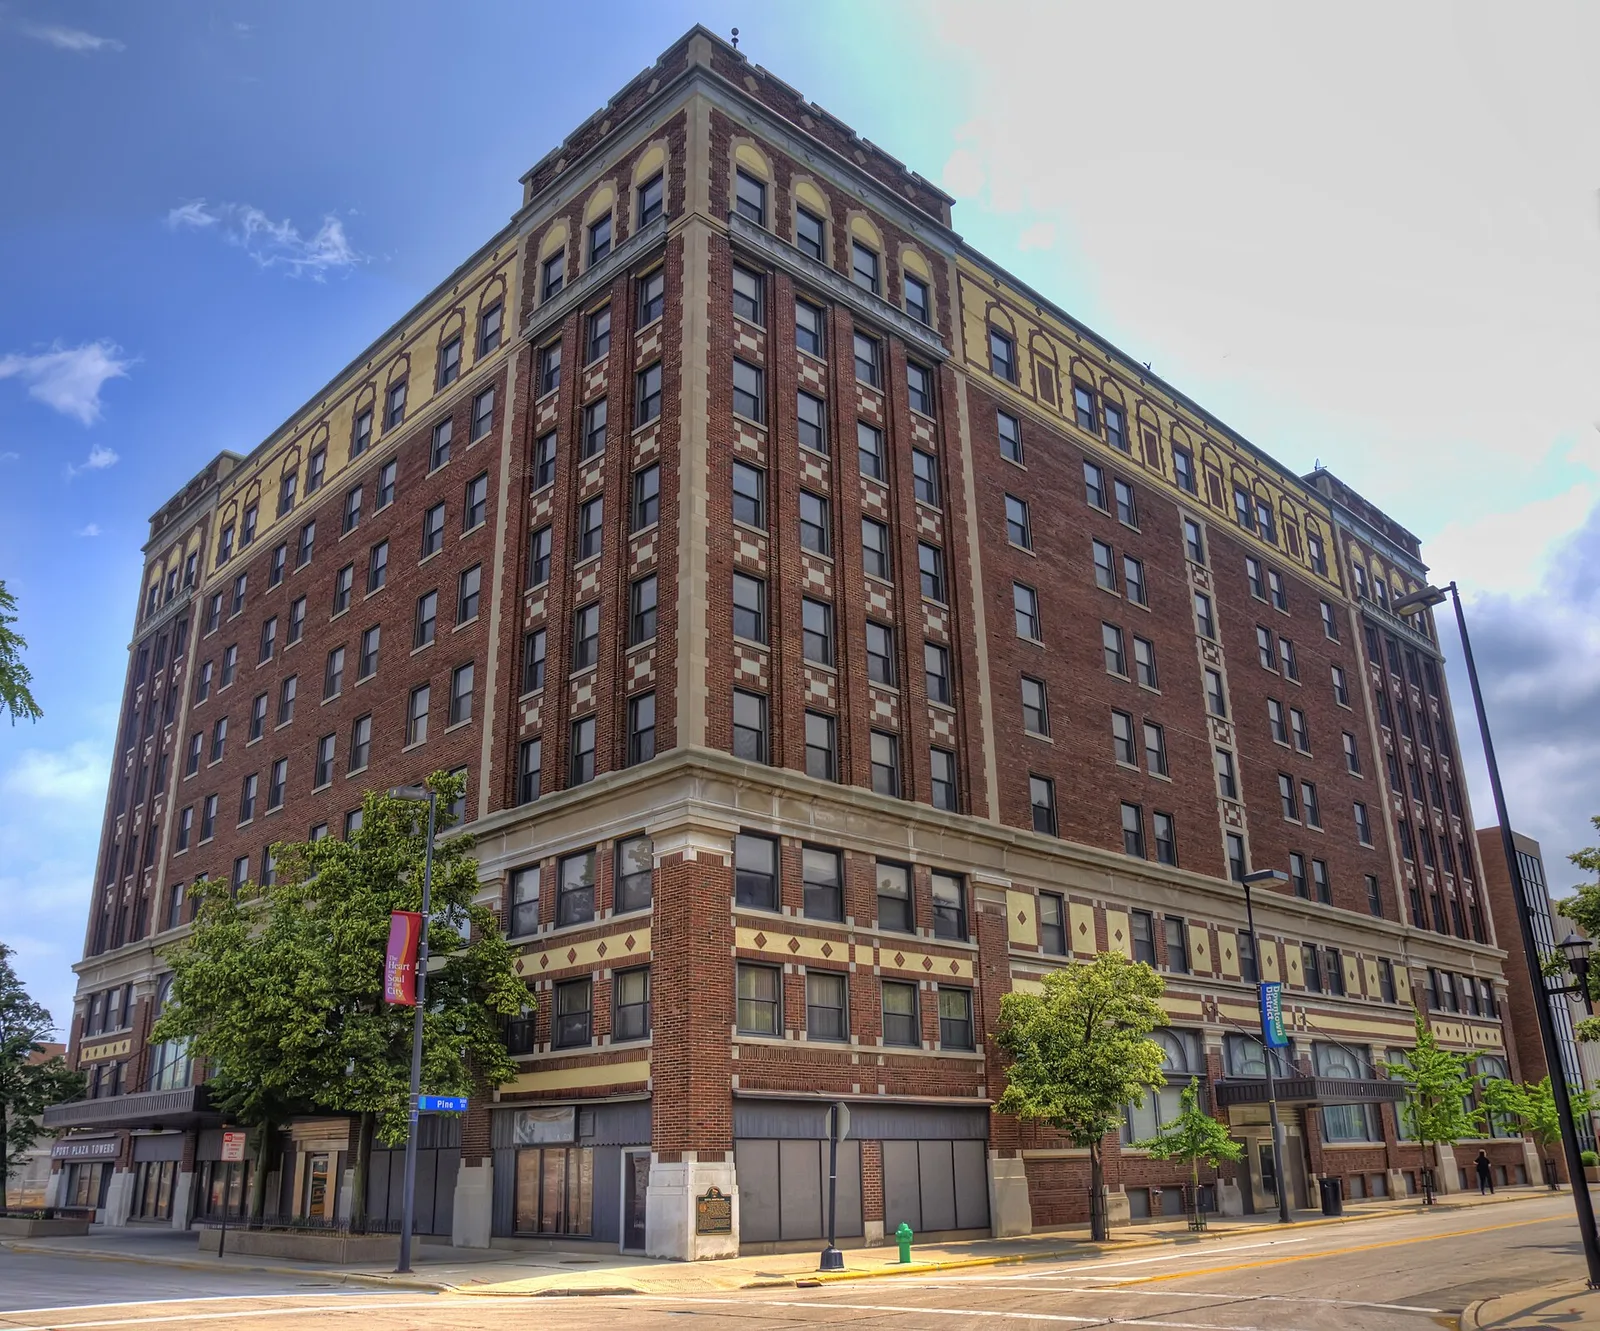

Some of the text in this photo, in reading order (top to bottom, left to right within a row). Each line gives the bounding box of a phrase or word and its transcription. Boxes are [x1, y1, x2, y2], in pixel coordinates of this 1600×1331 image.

[388, 961, 410, 971] Heart
[387, 974, 405, 983] Soul
[387, 987, 404, 998] City
[1266, 986, 1274, 1020] District
[1273, 986, 1283, 1036] Downtown
[437, 1100, 454, 1109] Pine
[72, 1145, 89, 1155] PLAZA
[91, 1143, 115, 1154] TOWERS
